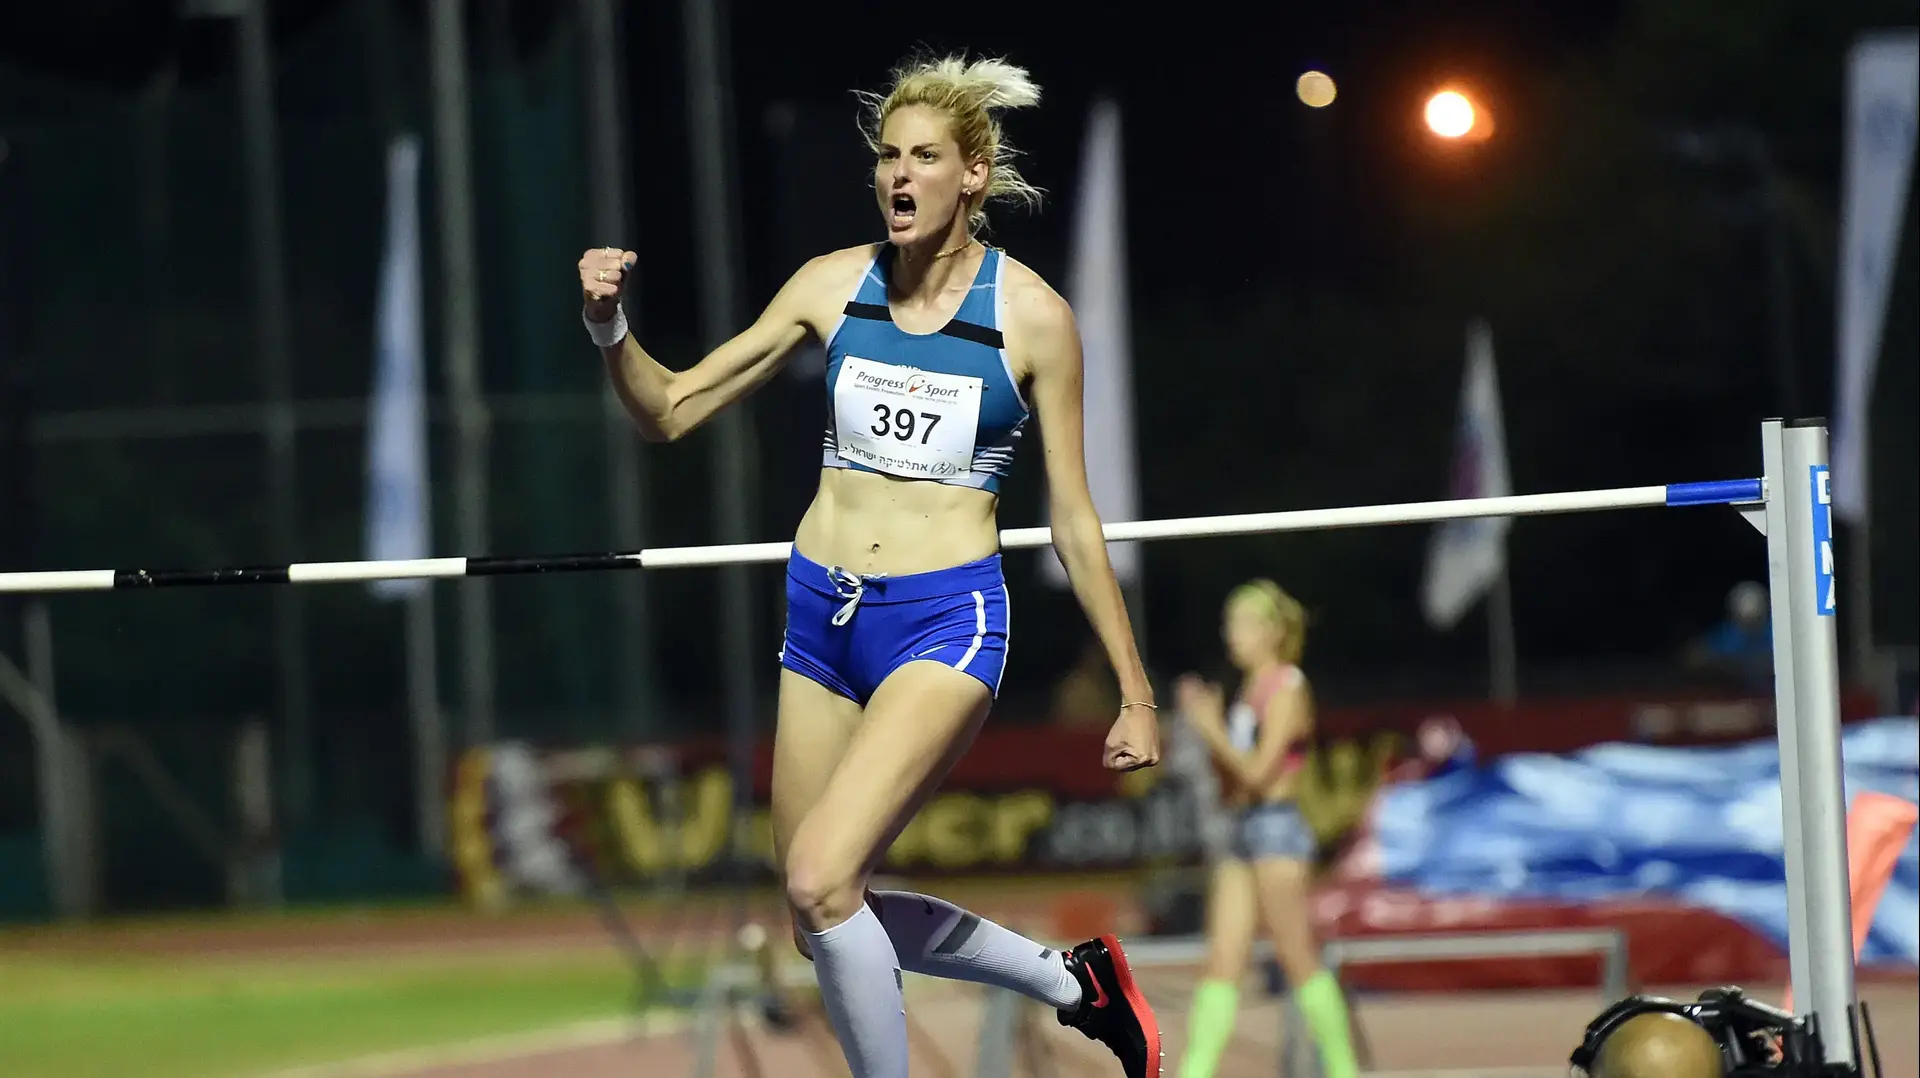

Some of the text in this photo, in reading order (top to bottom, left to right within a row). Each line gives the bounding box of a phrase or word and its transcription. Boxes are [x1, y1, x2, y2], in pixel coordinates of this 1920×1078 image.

[856, 371, 959, 397] Progress Sport
[870, 404, 942, 445] 397
[850, 443, 928, 472] אתלטיקה ישראל
